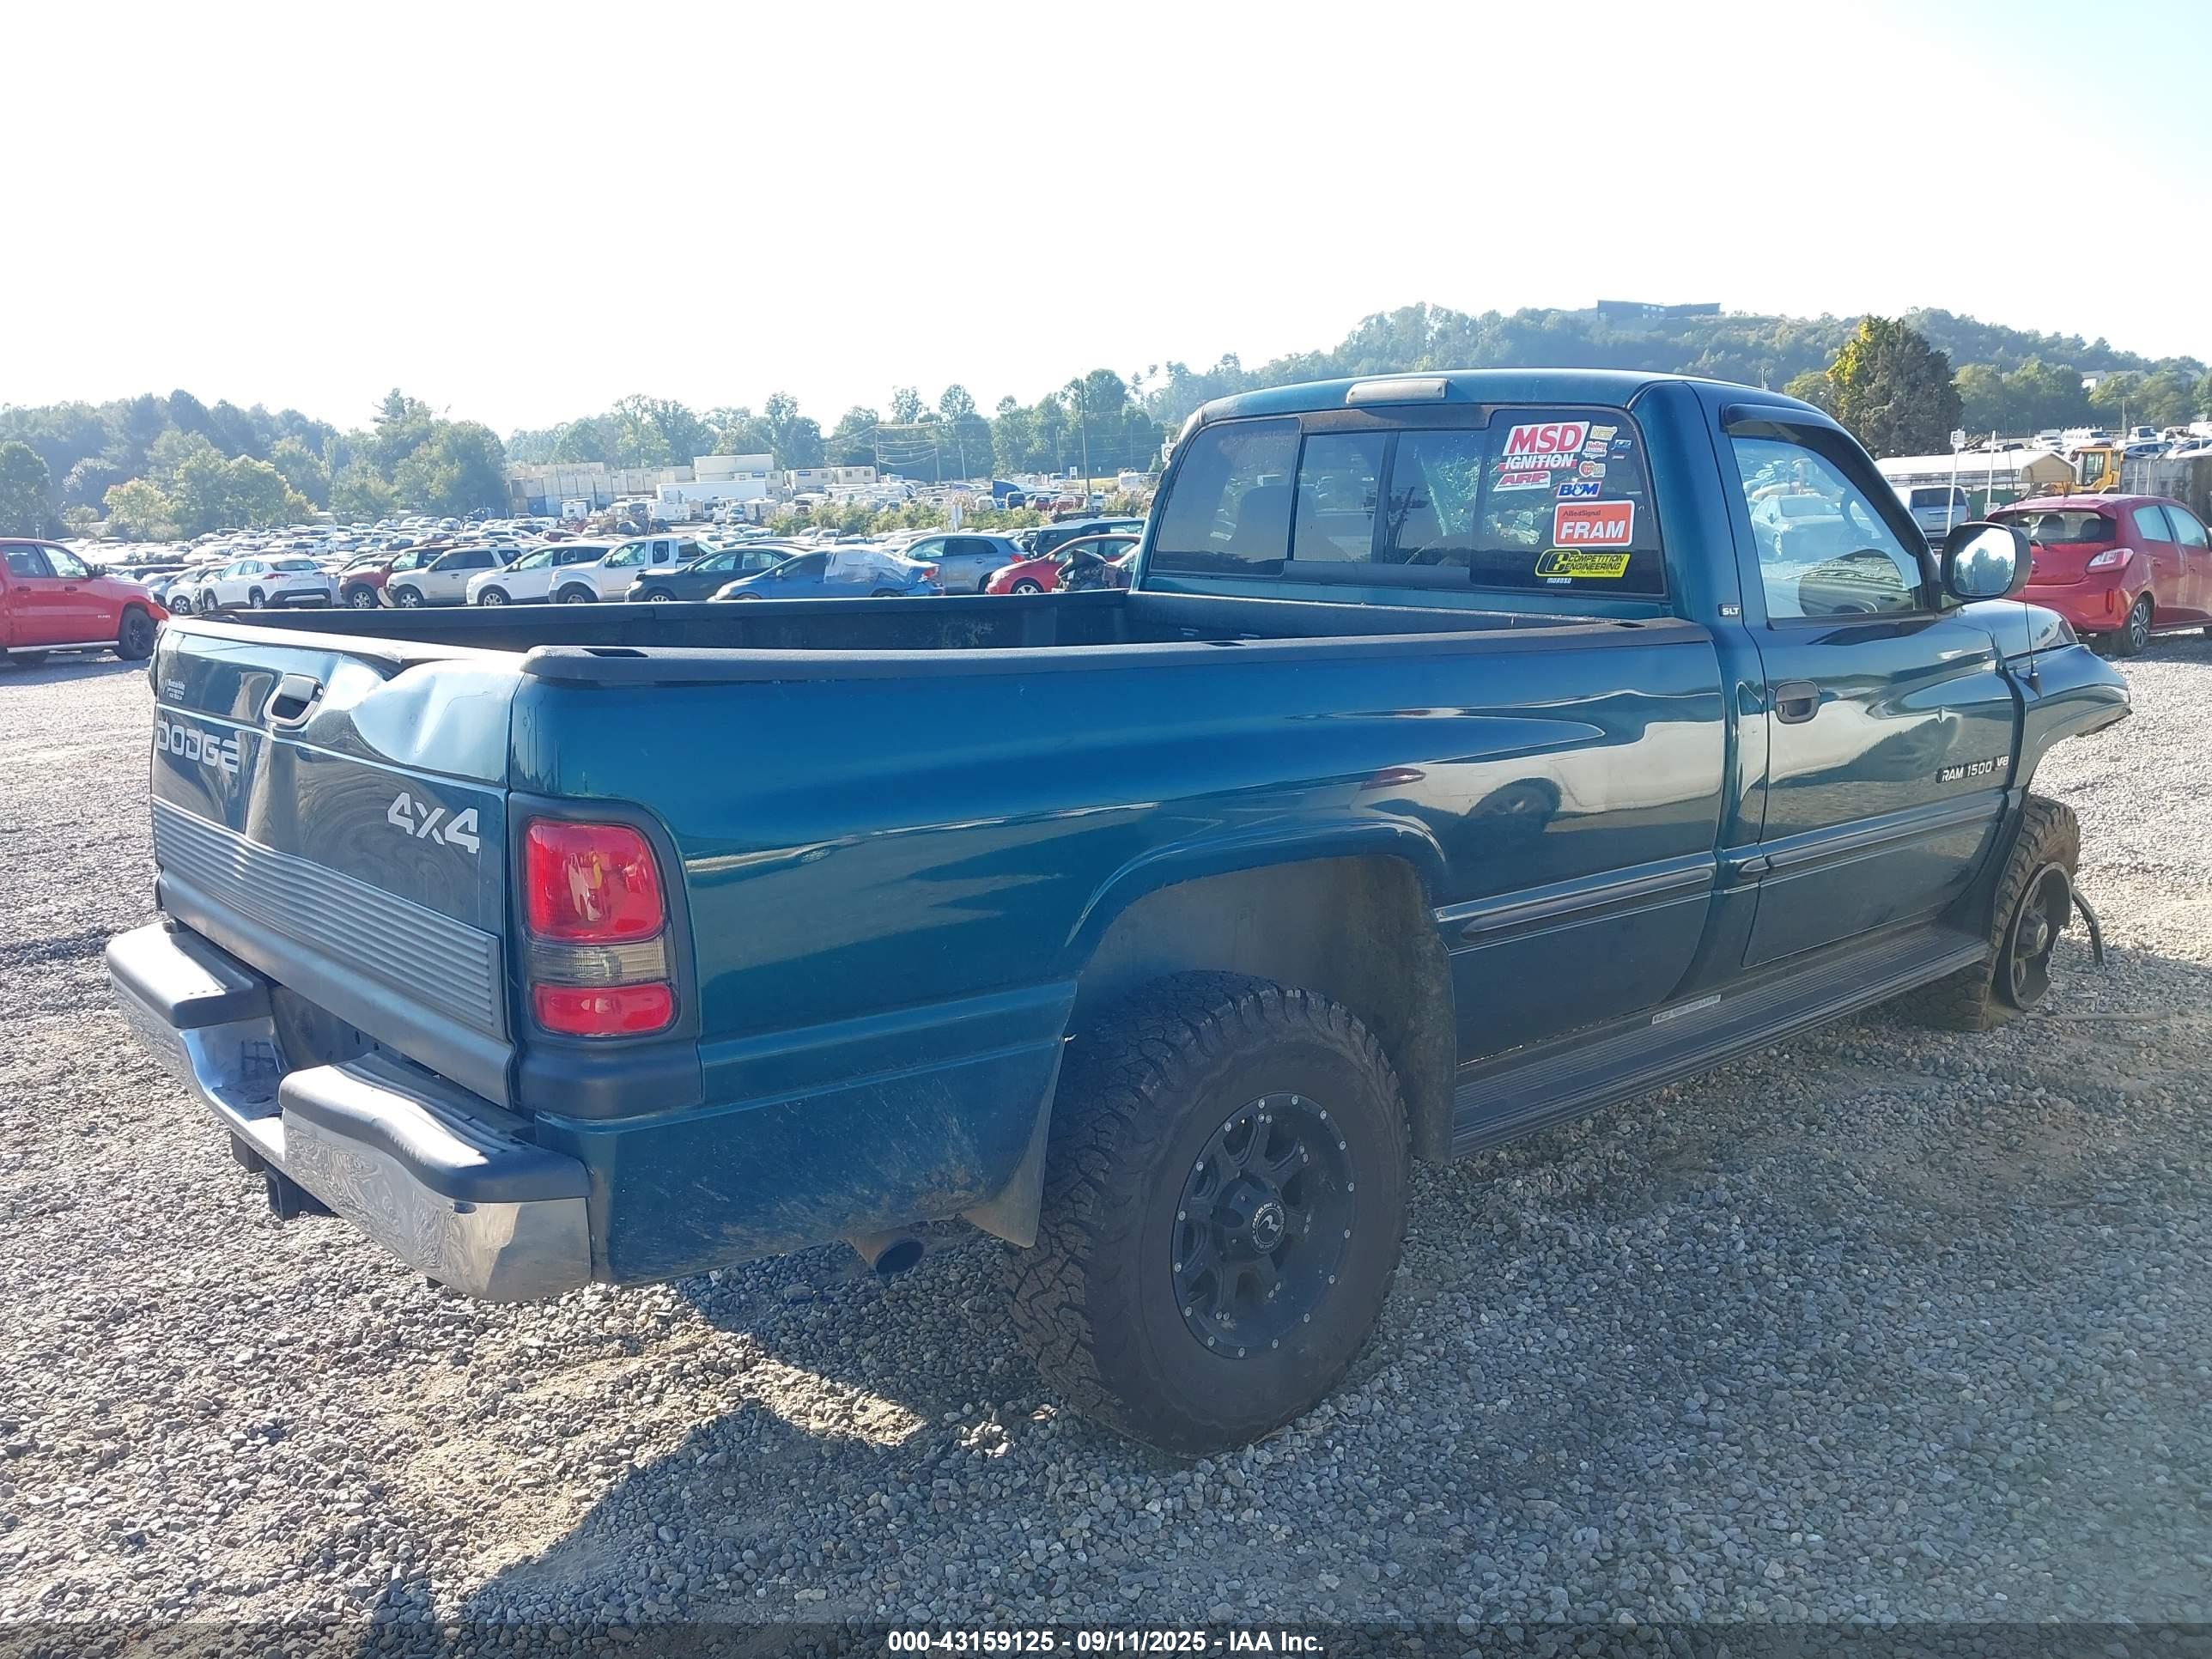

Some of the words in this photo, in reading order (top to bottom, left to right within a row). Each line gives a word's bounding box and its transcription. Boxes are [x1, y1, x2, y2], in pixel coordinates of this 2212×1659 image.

[1508, 424, 1583, 453] MSD
[1504, 453, 1575, 470] IGNITION
[1500, 472, 1548, 485] ARP
[1559, 483, 1600, 496] B&M
[1560, 520, 1626, 539] FRAM
[1723, 607, 1740, 616] SLT
[157, 720, 240, 773] DODGE
[1942, 766, 1964, 782] RAM
[1967, 761, 1993, 777] 1500
